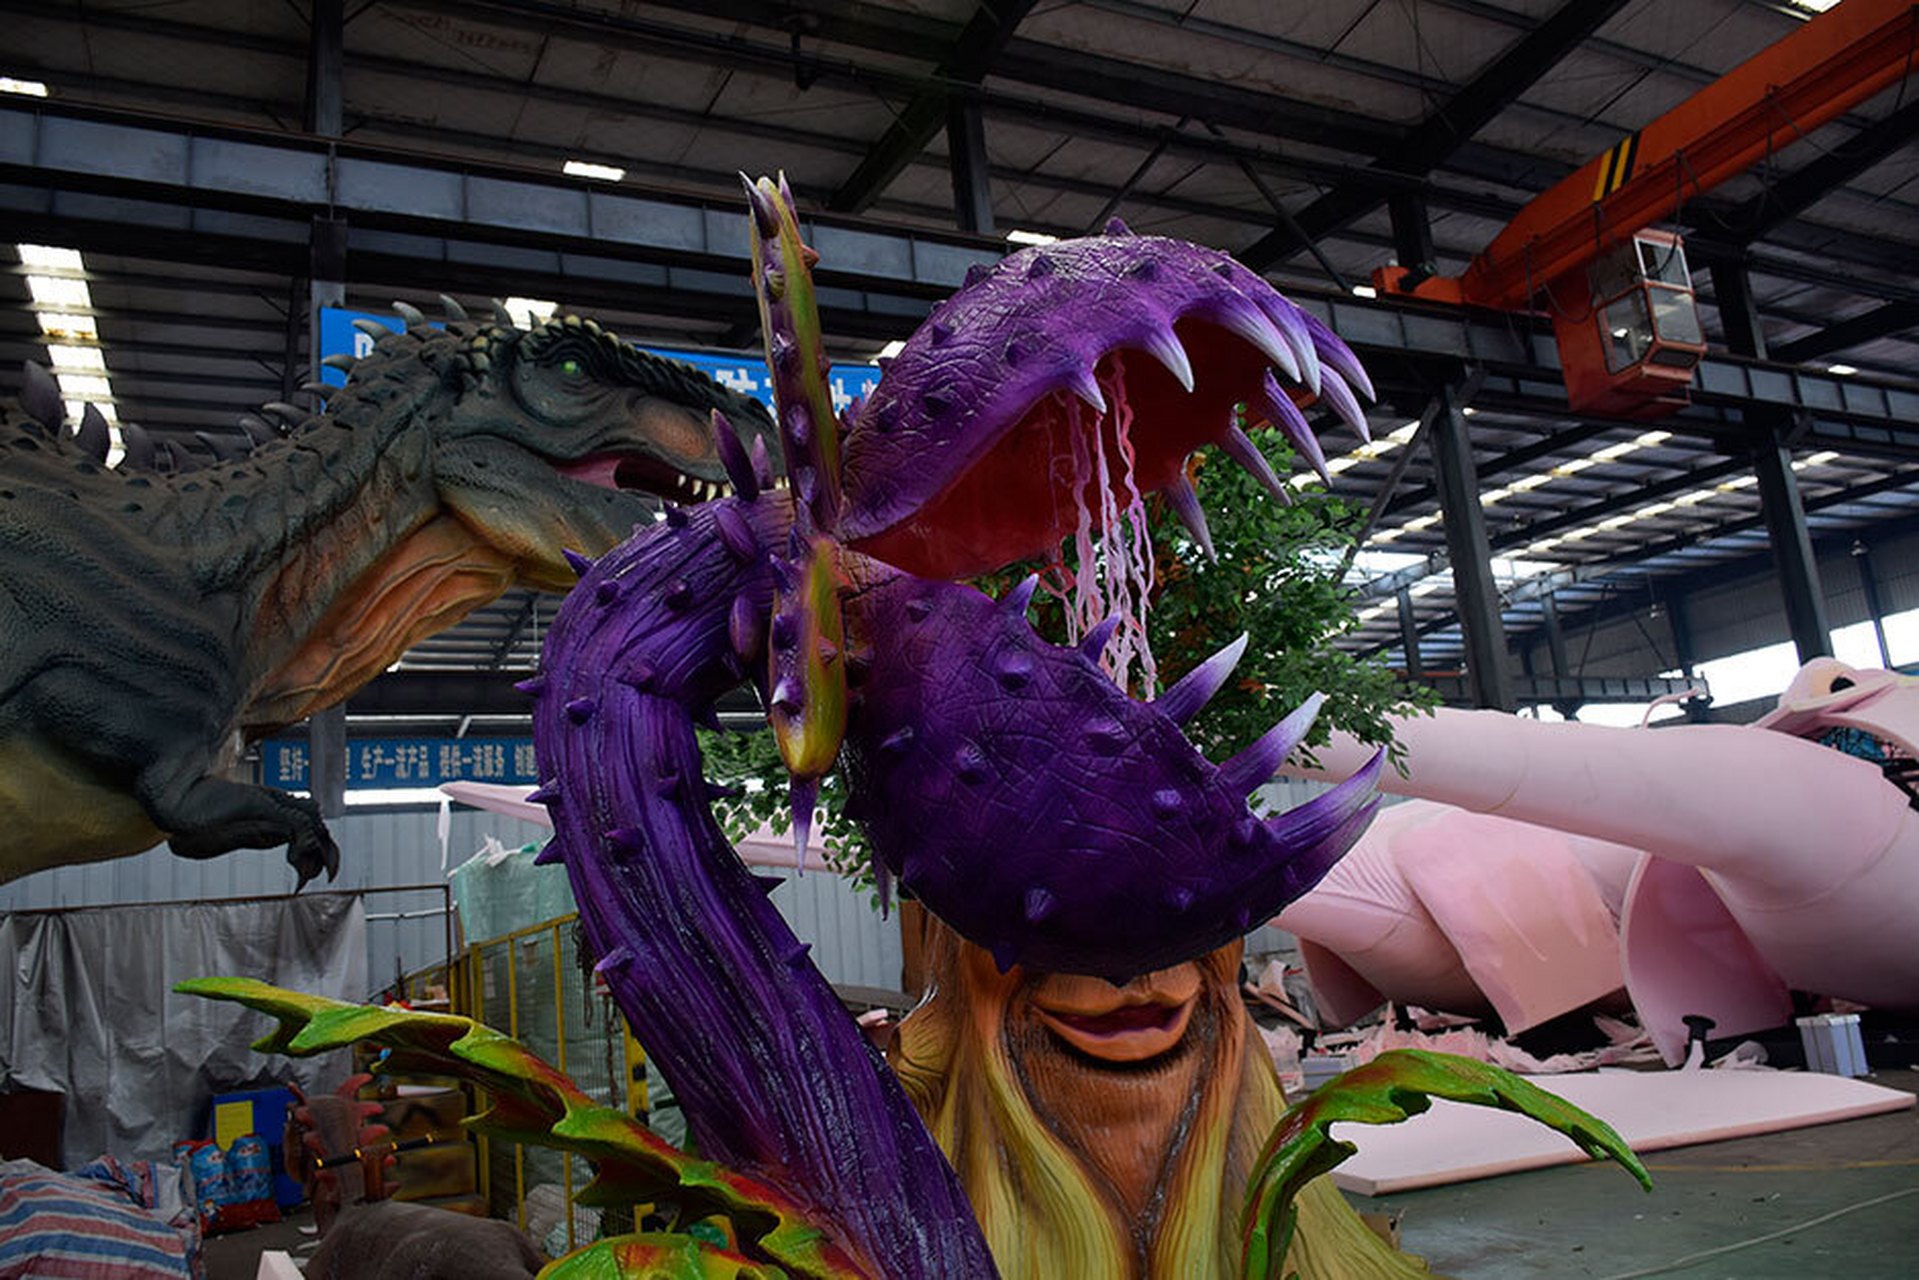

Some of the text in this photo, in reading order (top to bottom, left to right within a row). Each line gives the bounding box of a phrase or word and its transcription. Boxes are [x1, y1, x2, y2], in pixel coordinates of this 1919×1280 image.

[361, 745, 429, 780] 生产一流产品
[440, 744, 505, 778] 提供一流服务
